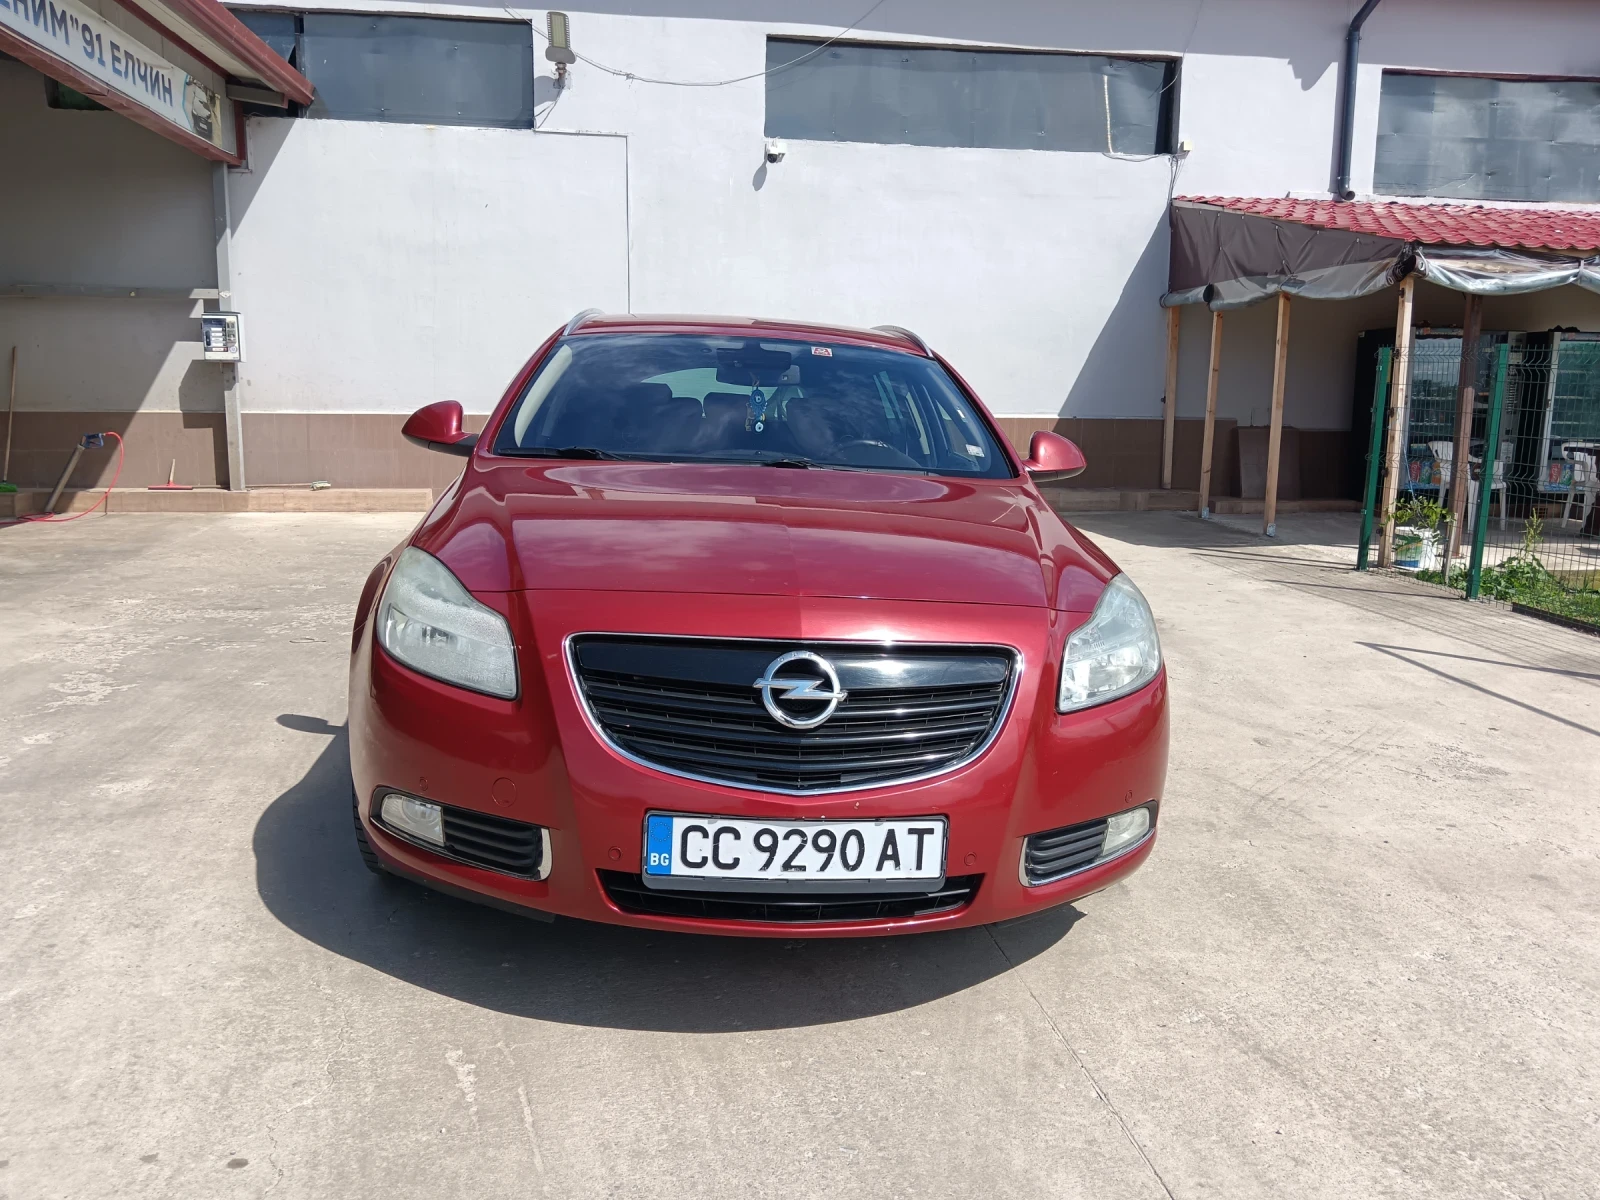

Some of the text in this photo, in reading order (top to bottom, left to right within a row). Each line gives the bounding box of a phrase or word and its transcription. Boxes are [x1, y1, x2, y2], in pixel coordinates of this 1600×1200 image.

[109, 39, 174, 108] ЕЛЧИН
[650, 852, 670, 867] BG
[680, 824, 935, 873] CC 9290 AT
